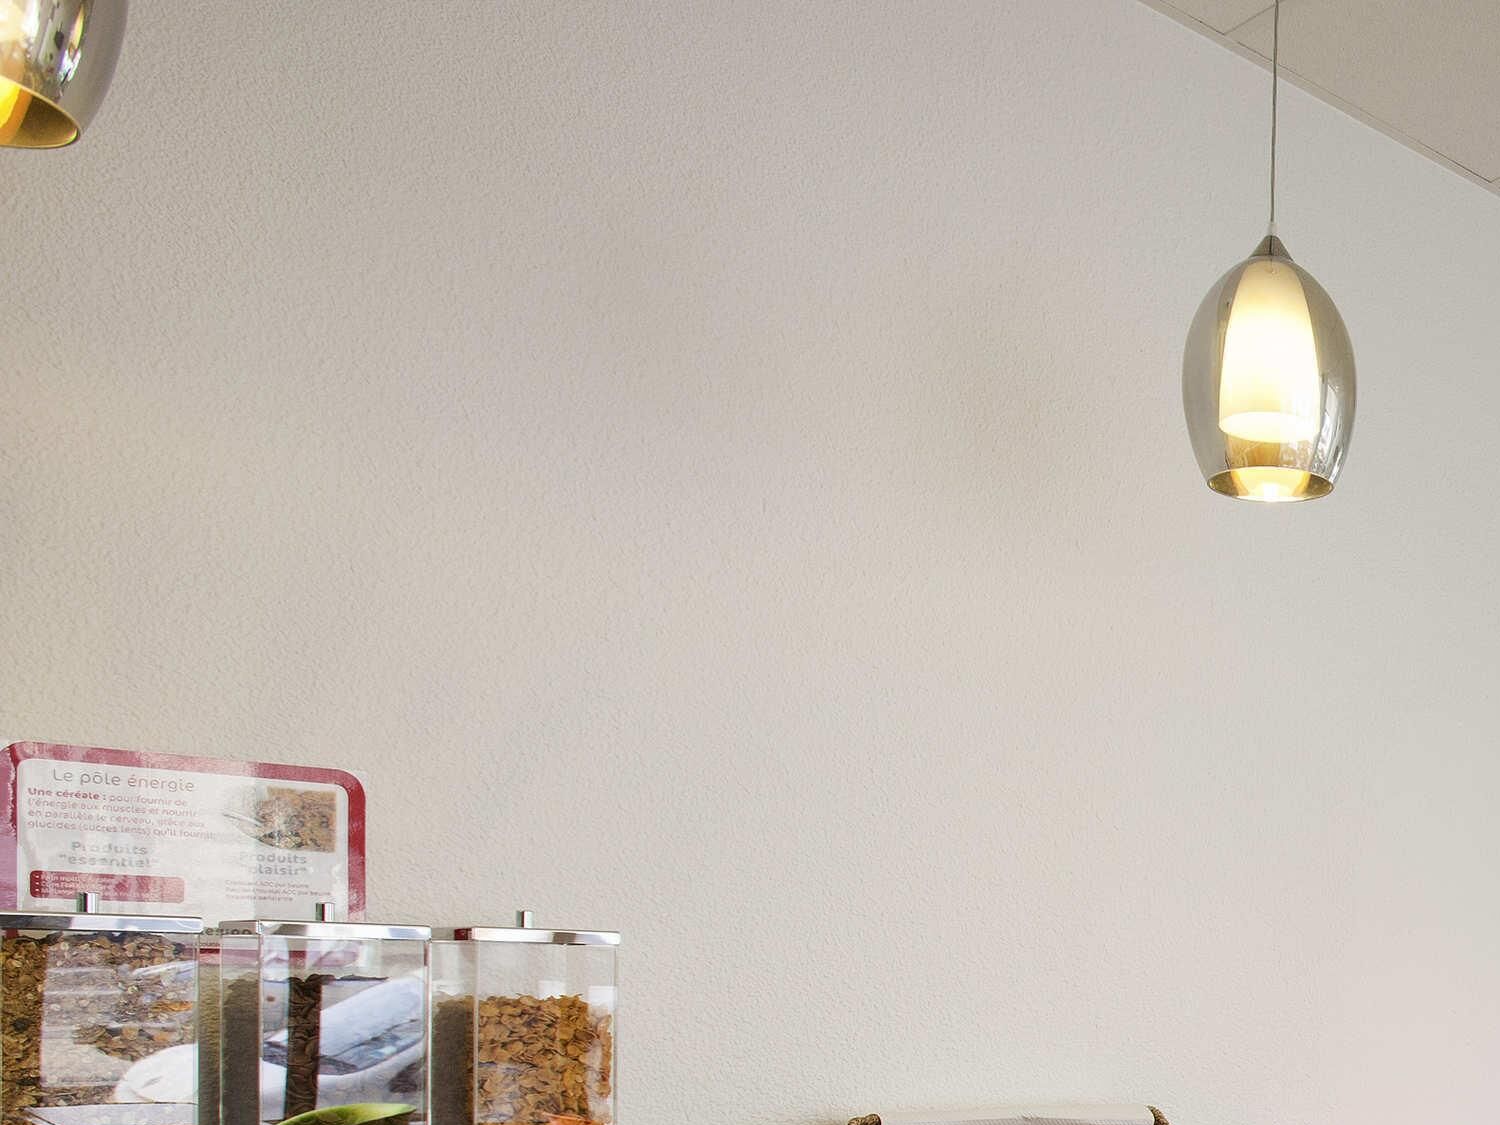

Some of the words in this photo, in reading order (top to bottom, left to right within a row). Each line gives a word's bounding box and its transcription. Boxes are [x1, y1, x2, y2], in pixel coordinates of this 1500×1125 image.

[53, 767, 73, 782] Le
[80, 771, 121, 786] pôle
[128, 773, 194, 793] énergie
[27, 787, 53, 797] Une
